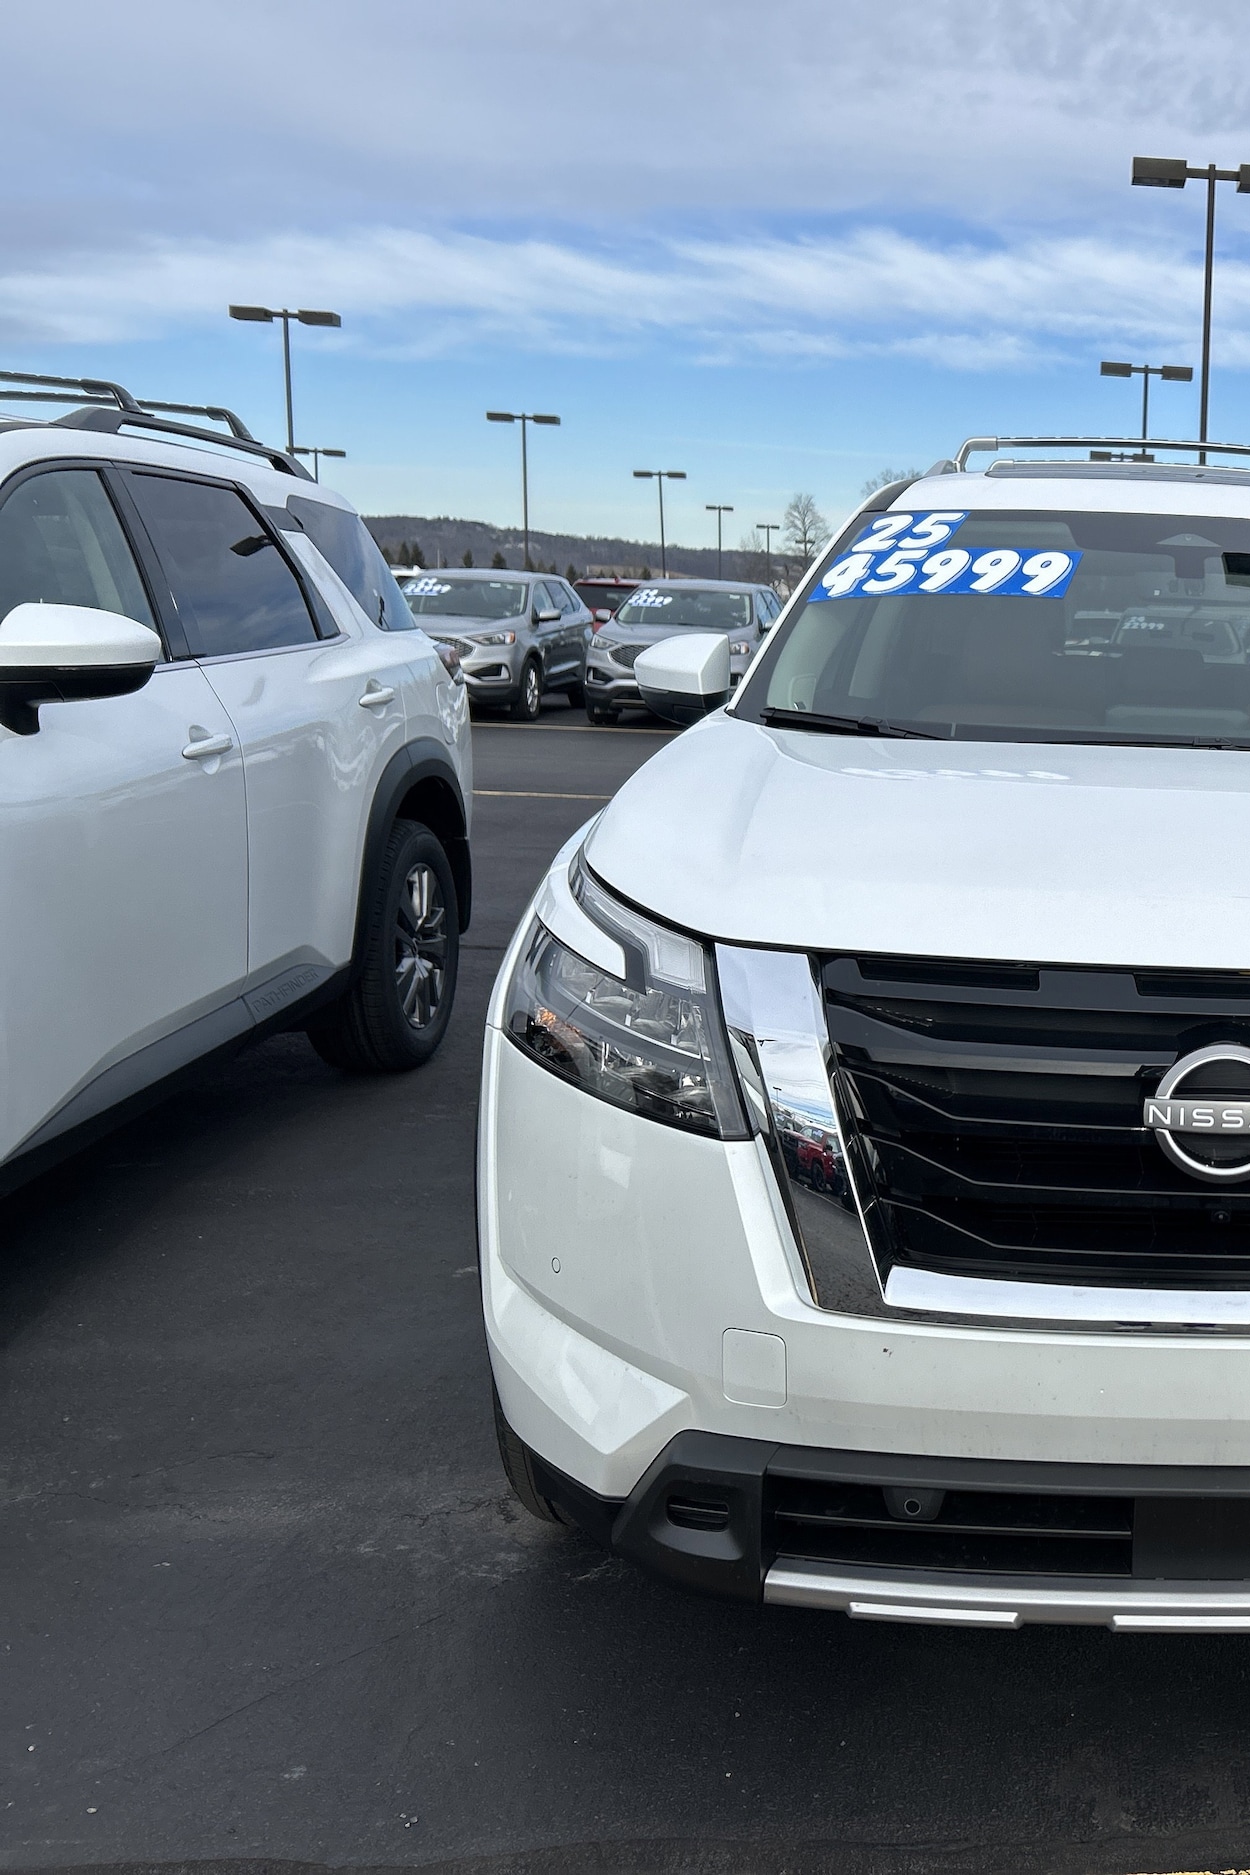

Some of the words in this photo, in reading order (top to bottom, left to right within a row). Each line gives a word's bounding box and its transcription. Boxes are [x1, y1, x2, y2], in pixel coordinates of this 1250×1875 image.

[851, 512, 966, 553] 25
[821, 549, 1074, 598] 45999
[252, 967, 320, 1013] PATHFINDER
